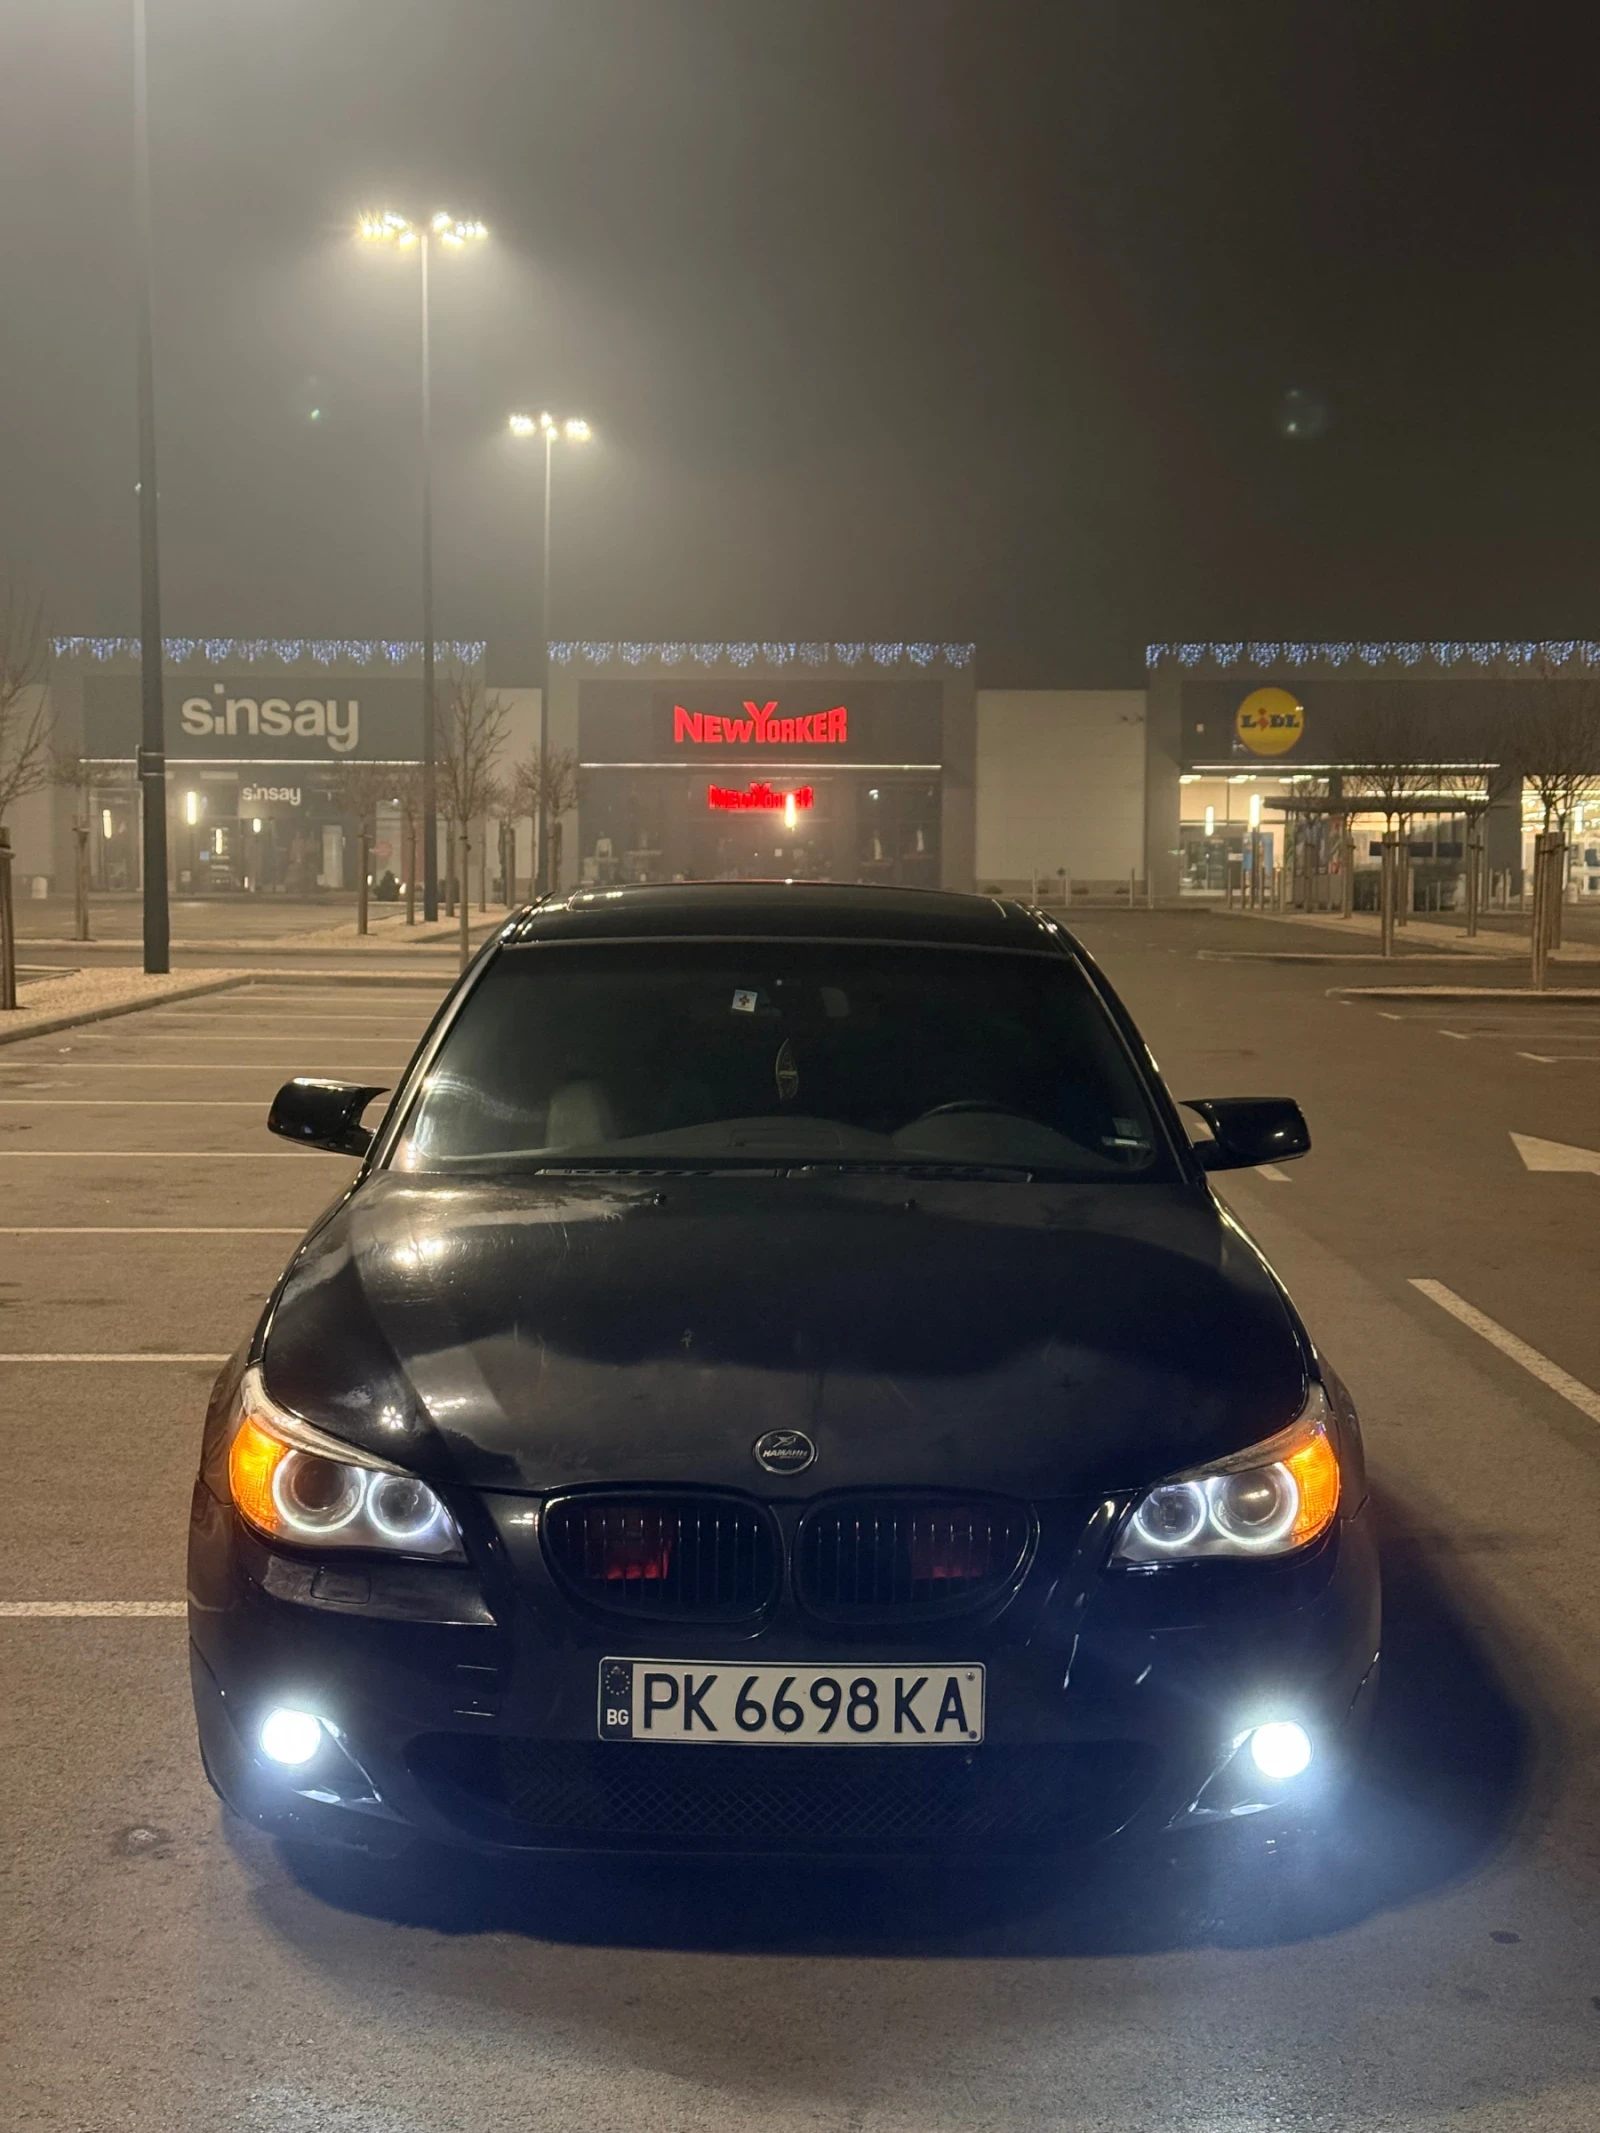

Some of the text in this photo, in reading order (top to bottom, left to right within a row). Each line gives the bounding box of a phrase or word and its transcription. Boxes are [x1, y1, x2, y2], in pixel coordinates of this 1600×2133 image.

[181, 683, 359, 752] sinsay
[242, 783, 301, 806] sinsay
[607, 1709, 629, 1725] BG
[643, 1672, 969, 1734] PK 6698 KA
